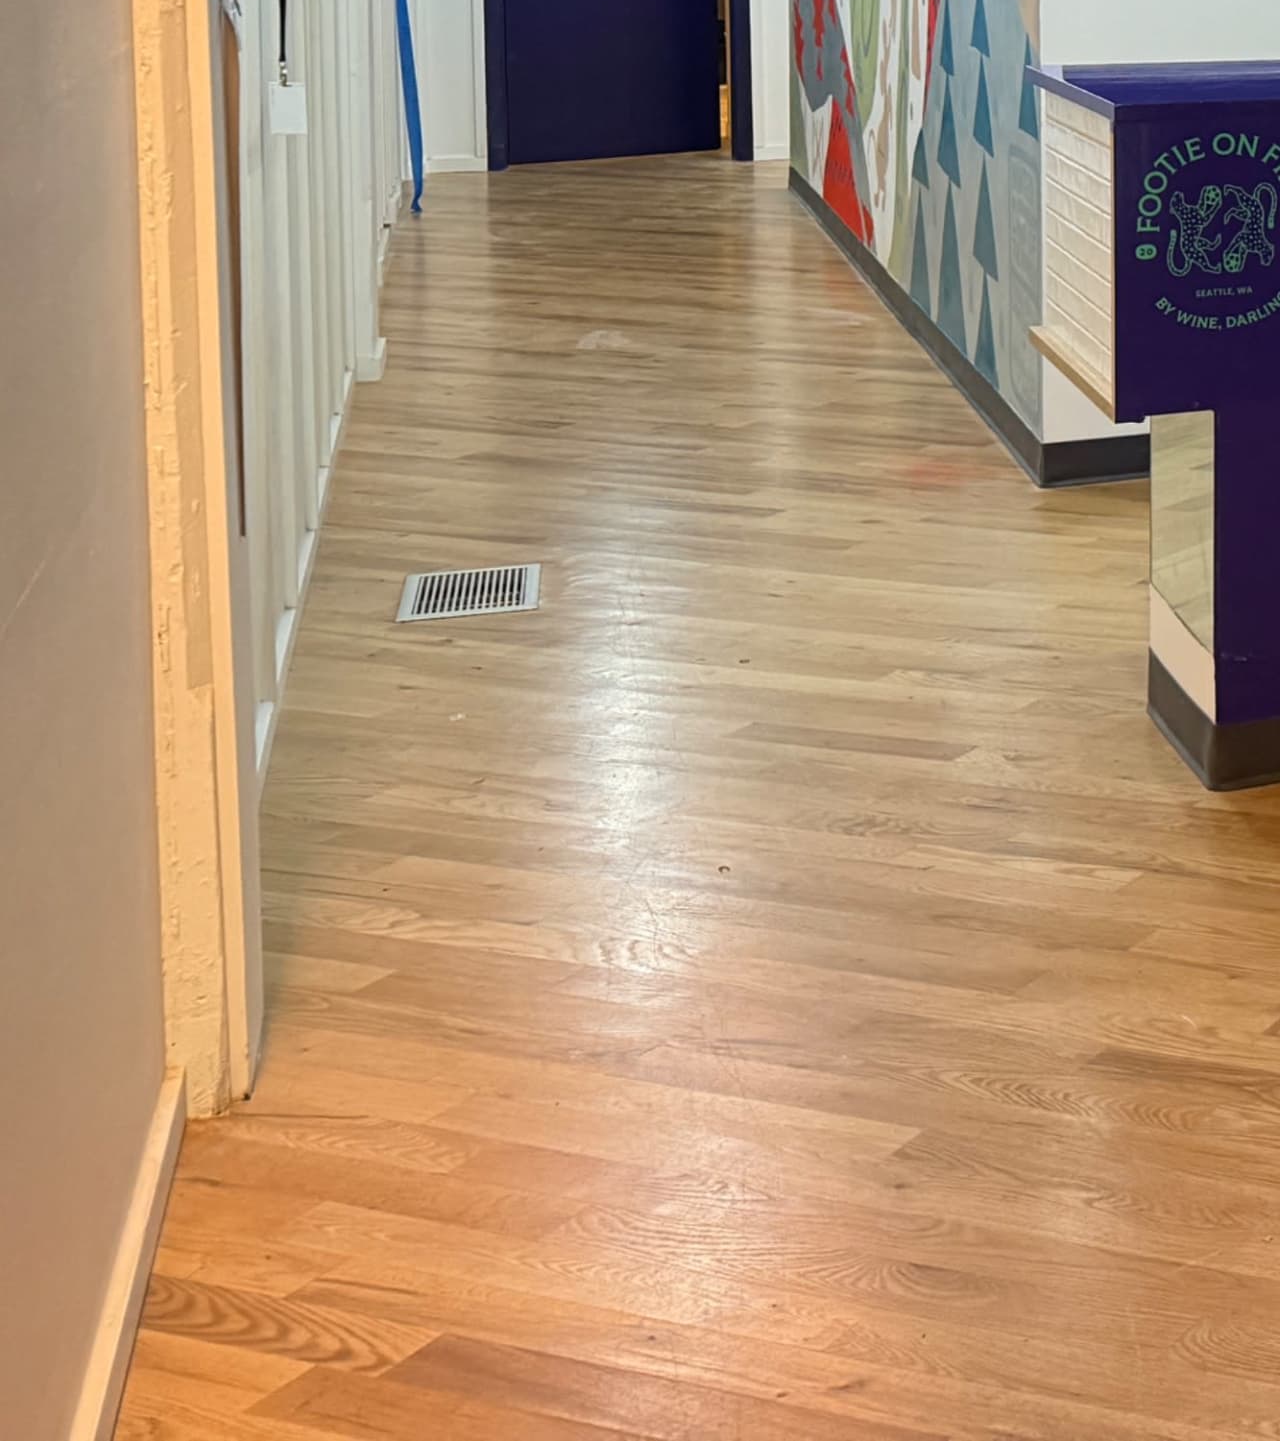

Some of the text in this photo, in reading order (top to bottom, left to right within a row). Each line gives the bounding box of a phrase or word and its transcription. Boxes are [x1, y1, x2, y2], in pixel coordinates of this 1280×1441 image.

[1136, 137, 1205, 233] FOOTIE
[1211, 132, 1260, 158] ON
[1154, 297, 1177, 316] BY
[1176, 309, 1222, 331] WINE,
